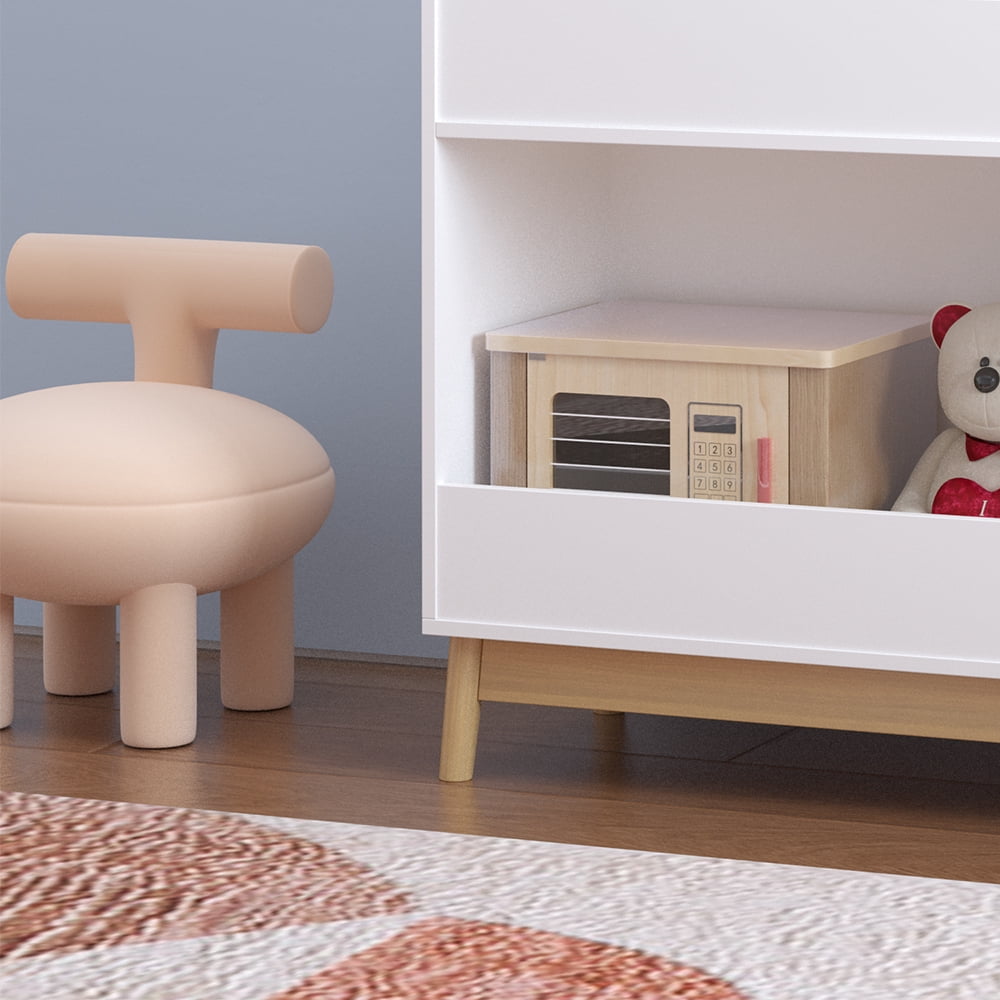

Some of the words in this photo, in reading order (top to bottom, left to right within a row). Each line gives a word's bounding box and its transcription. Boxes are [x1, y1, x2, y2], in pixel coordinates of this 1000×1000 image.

[698, 445, 702, 453] 1
[712, 445, 718, 454] 2
[727, 446, 733, 455] 3
[696, 462, 703, 471] 4
[712, 463, 718, 471] 5
[727, 463, 733, 472] 6
[697, 479, 703, 487] 7
[712, 480, 718, 488] 8
[727, 480, 733, 489] 9
